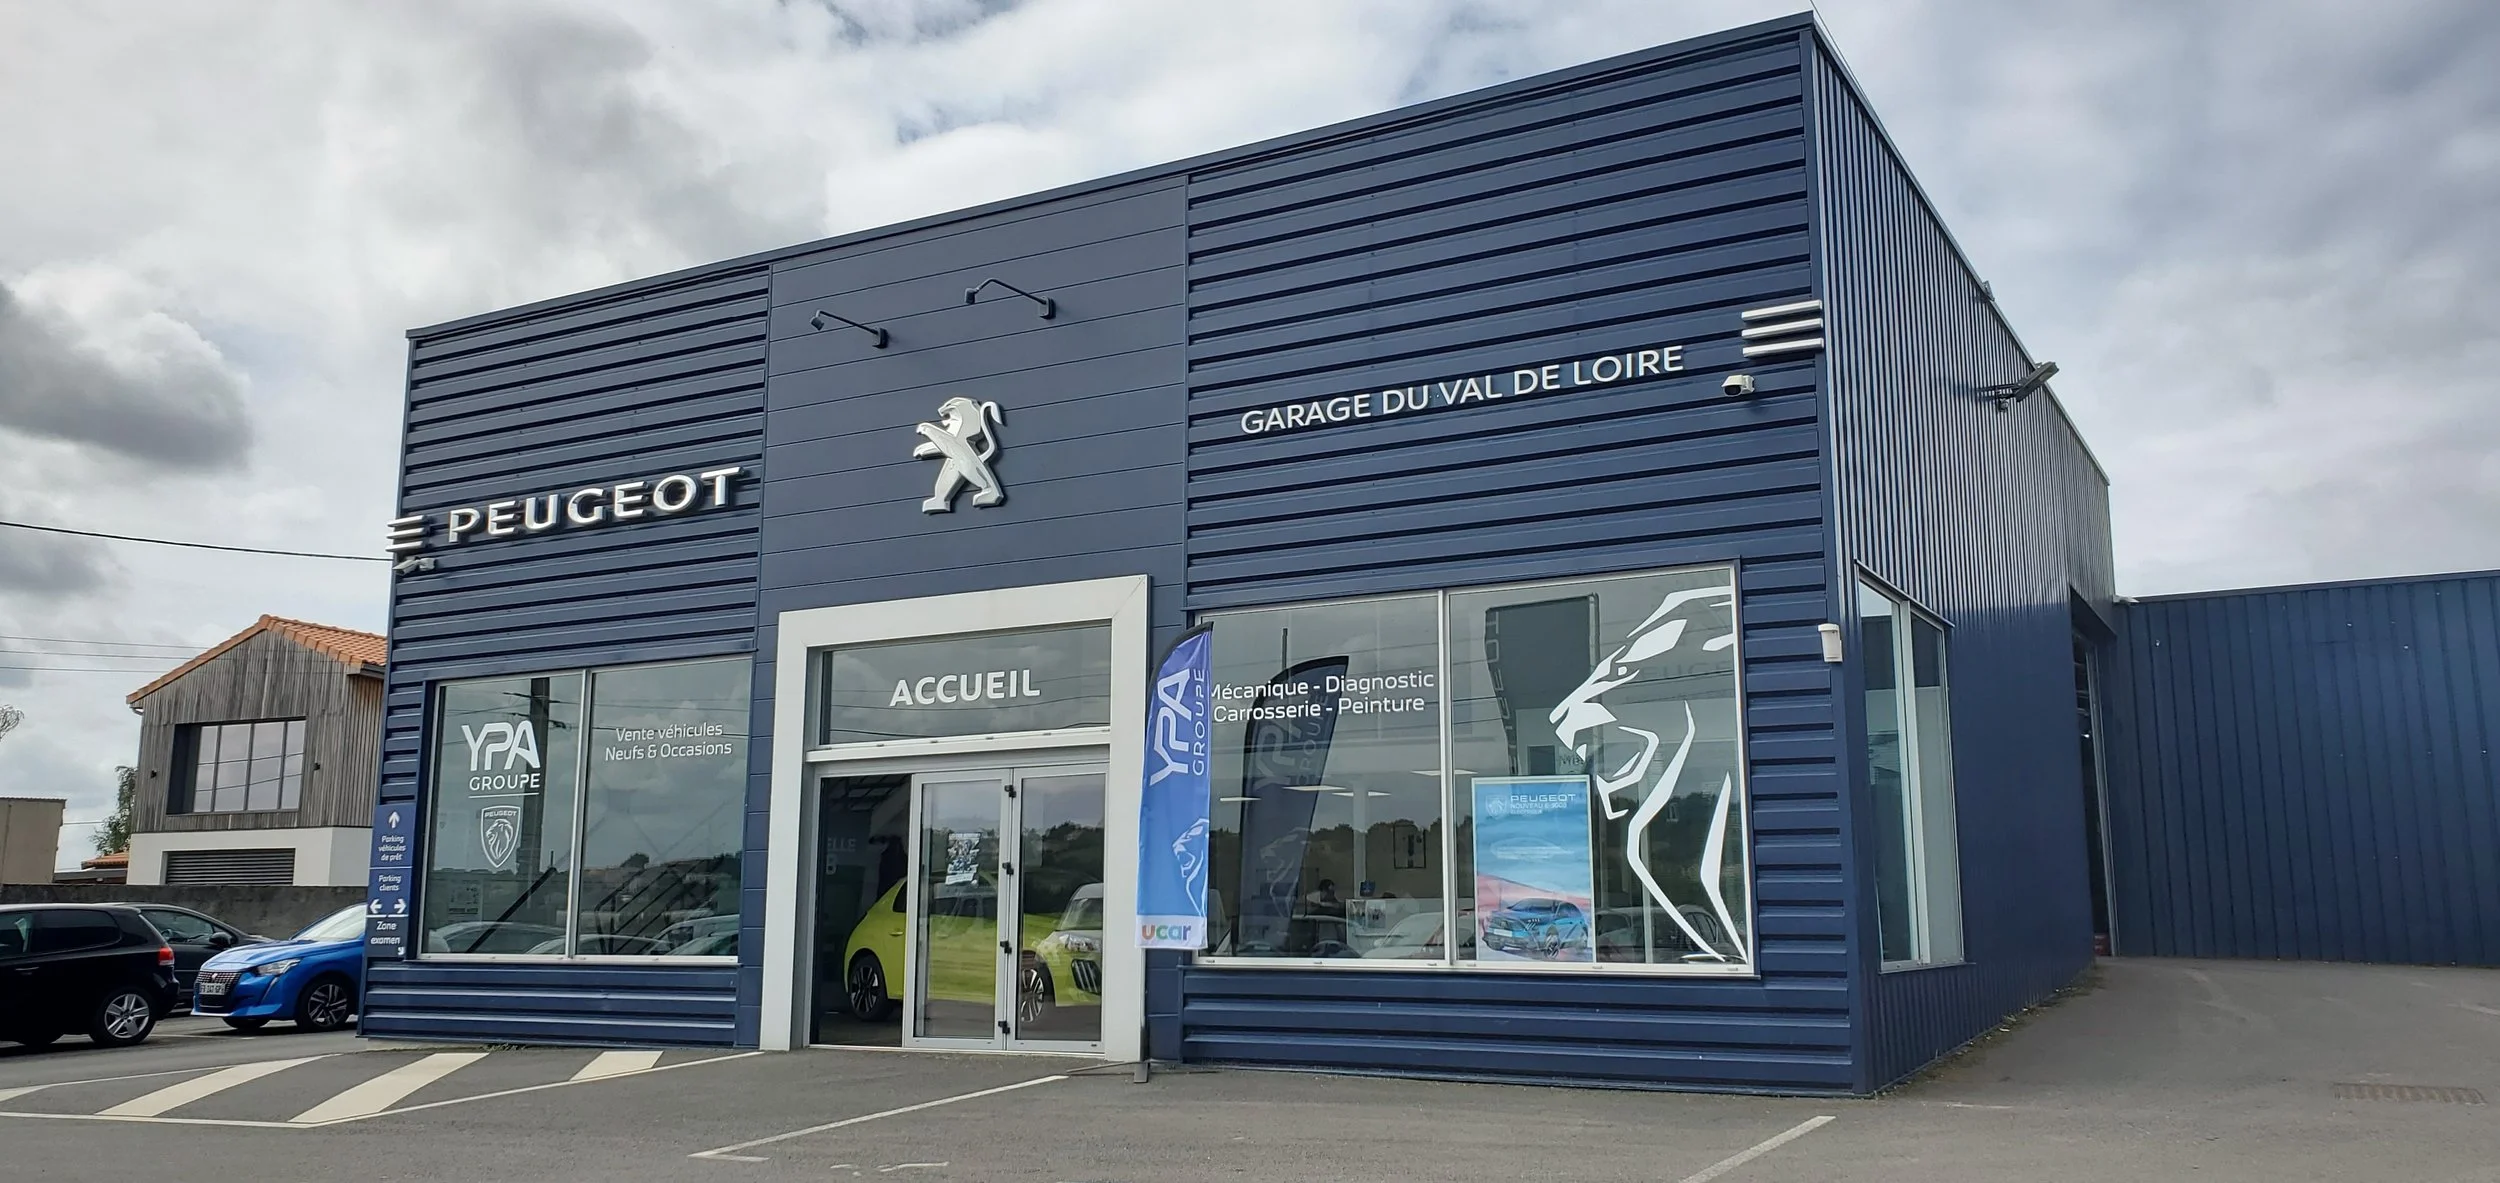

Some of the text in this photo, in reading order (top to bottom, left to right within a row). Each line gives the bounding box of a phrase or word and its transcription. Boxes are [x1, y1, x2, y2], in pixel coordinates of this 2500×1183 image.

[1241, 346, 1683, 434] GARAGE DU VAL DE LOIRE
[448, 466, 745, 544] PEUGEOT
[889, 669, 1041, 707] ACCUEIL
[1211, 681, 1309, 700] Mécanique
[1325, 671, 1434, 694] Diagnostic
[1213, 703, 1322, 722] Carrosserie
[1338, 696, 1425, 716] Peinture
[616, 721, 723, 742] Vente véhicules
[1150, 668, 1192, 787] YPA
[1192, 668, 1206, 776] GROUPE
[461, 720, 541, 772] YPA
[605, 741, 732, 761] Neufs & Occasions
[469, 772, 541, 792] GROUPE
[1510, 793, 1576, 803] PEUGEOT
[484, 810, 518, 818] PEUGEOT
[381, 835, 405, 844] Parking
[381, 853, 389, 861] de
[378, 874, 402, 883] Parking
[376, 920, 398, 930] Zone
[1142, 924, 1191, 940] ucar
[370, 936, 401, 945] examen
